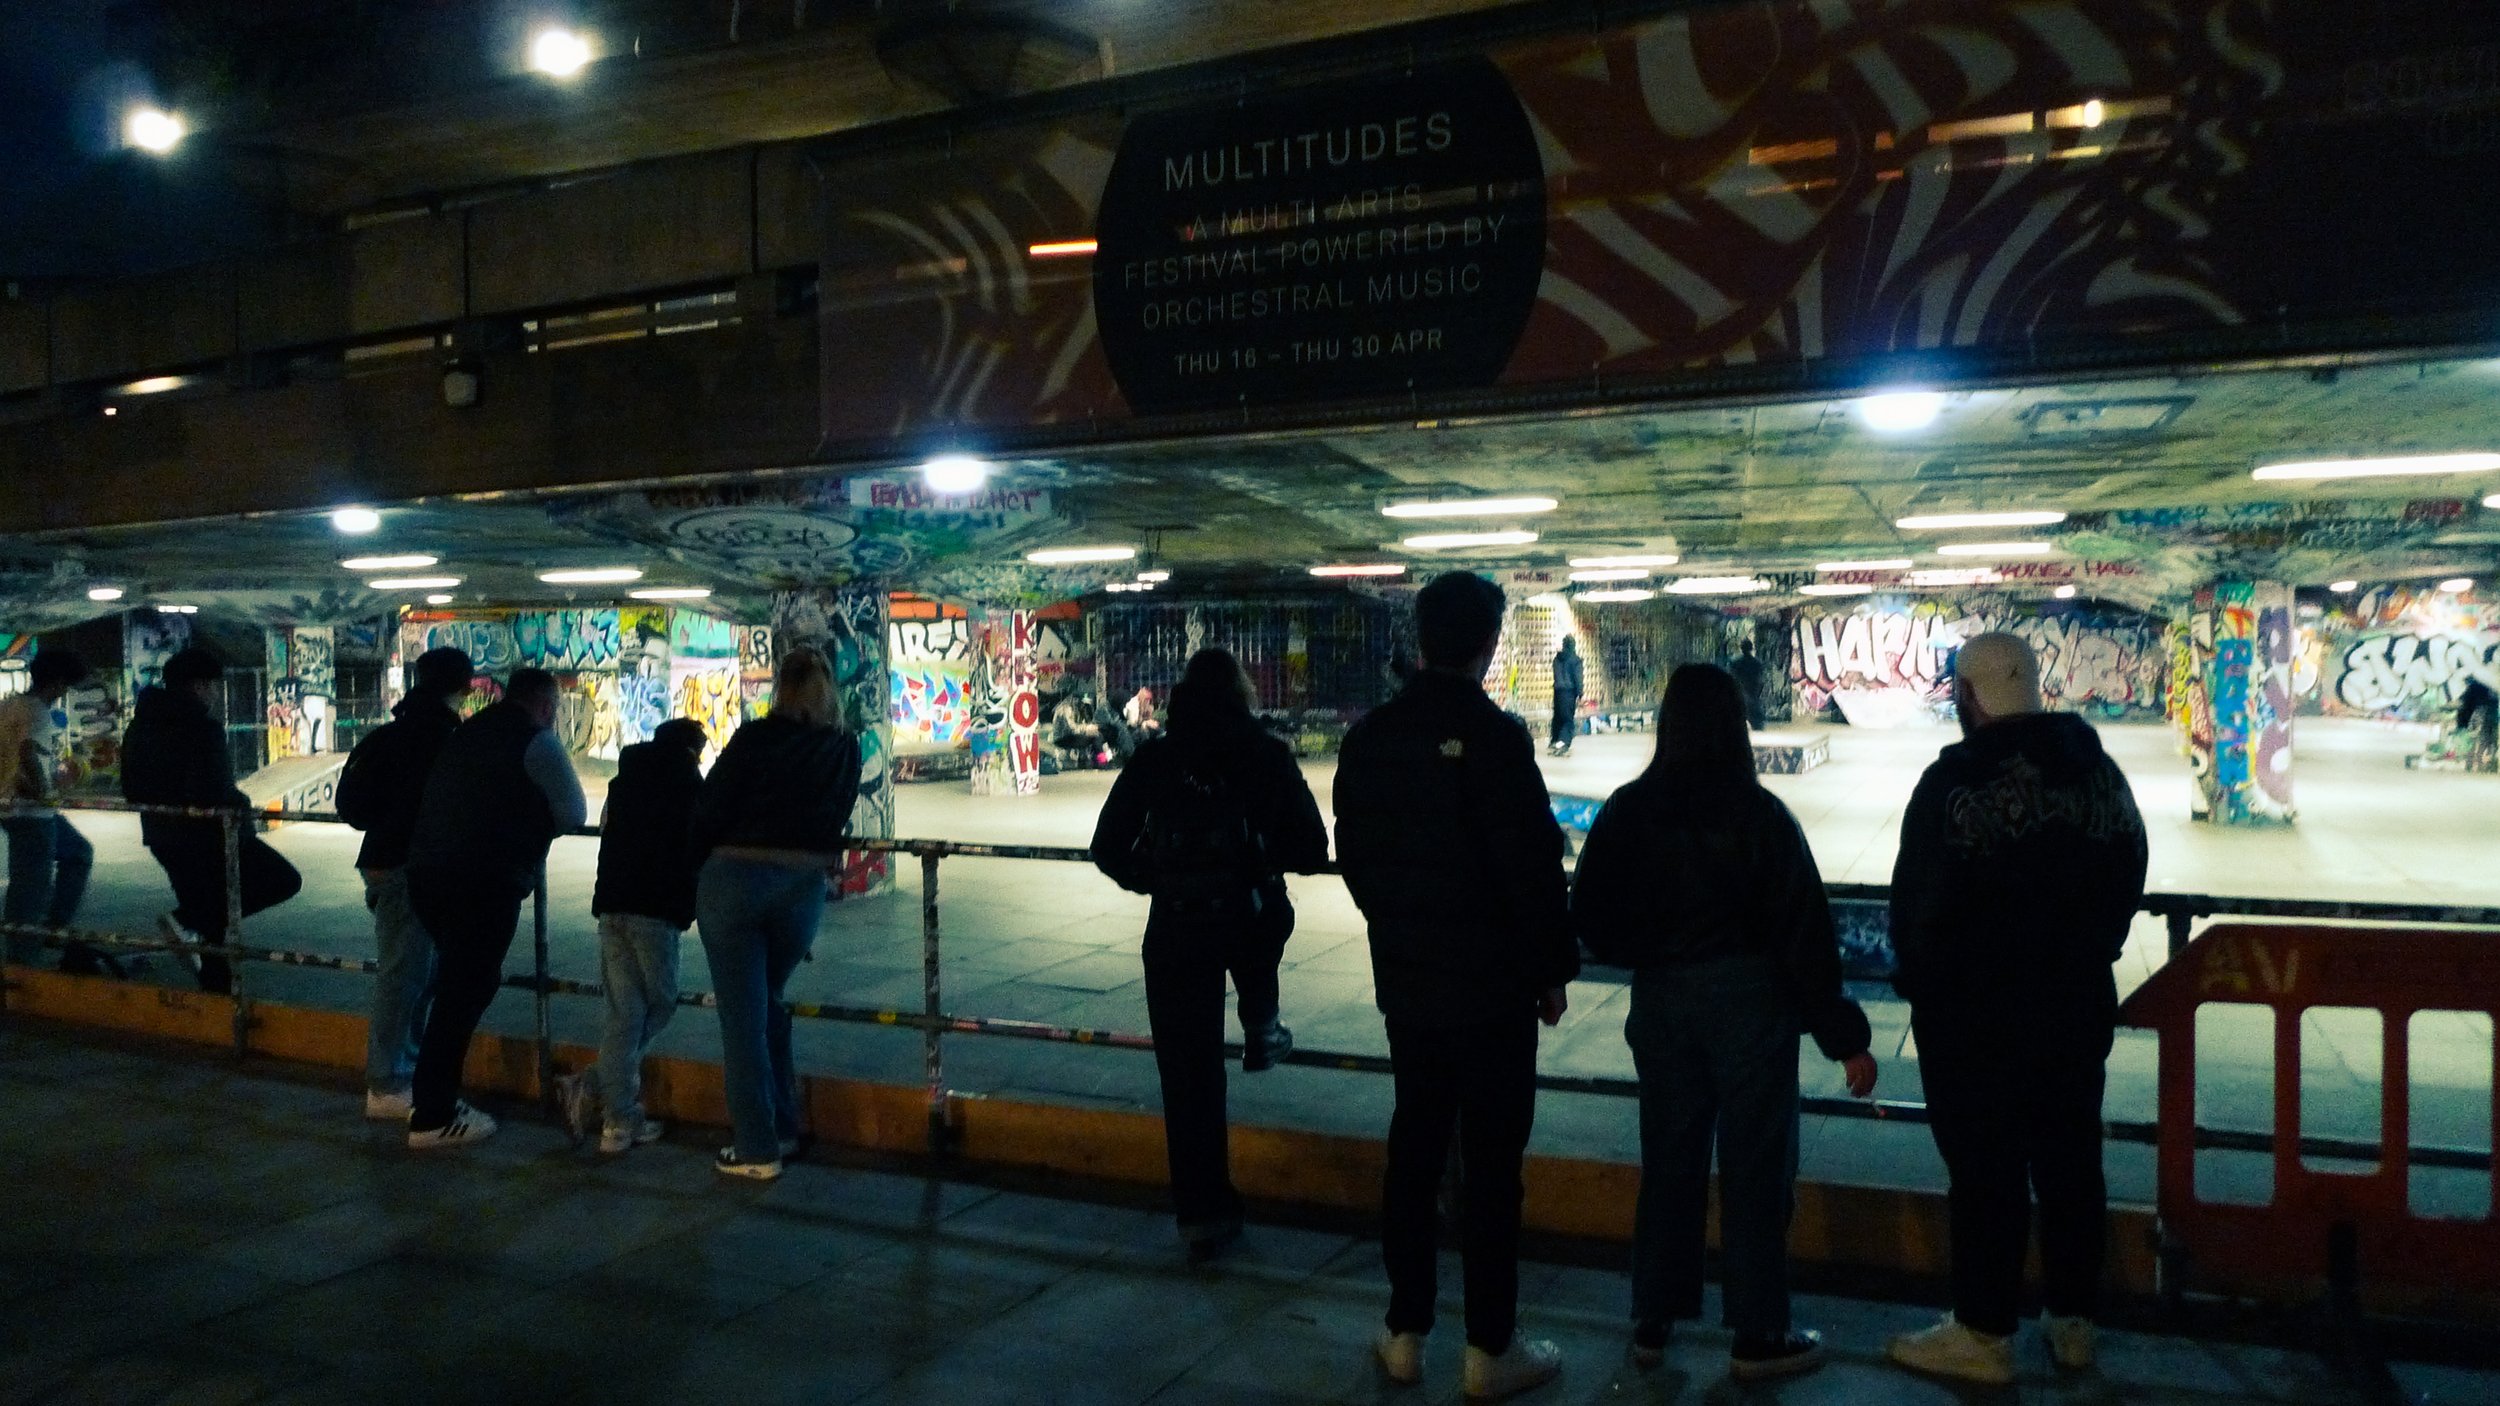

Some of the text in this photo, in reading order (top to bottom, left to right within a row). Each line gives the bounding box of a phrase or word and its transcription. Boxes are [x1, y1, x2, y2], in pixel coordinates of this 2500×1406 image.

[1164, 111, 1454, 192] MULTITUDES
[1192, 182, 1424, 242] A MULTI ARTS
[1125, 214, 1505, 290] FESTIVAL POWERED BY
[1143, 263, 1482, 330] ORCHESTRAL MUSIC
[1175, 352, 1220, 376] THU
[1291, 336, 1341, 364] THU
[1352, 337, 1381, 359] 30
[1391, 328, 1443, 353] APR
